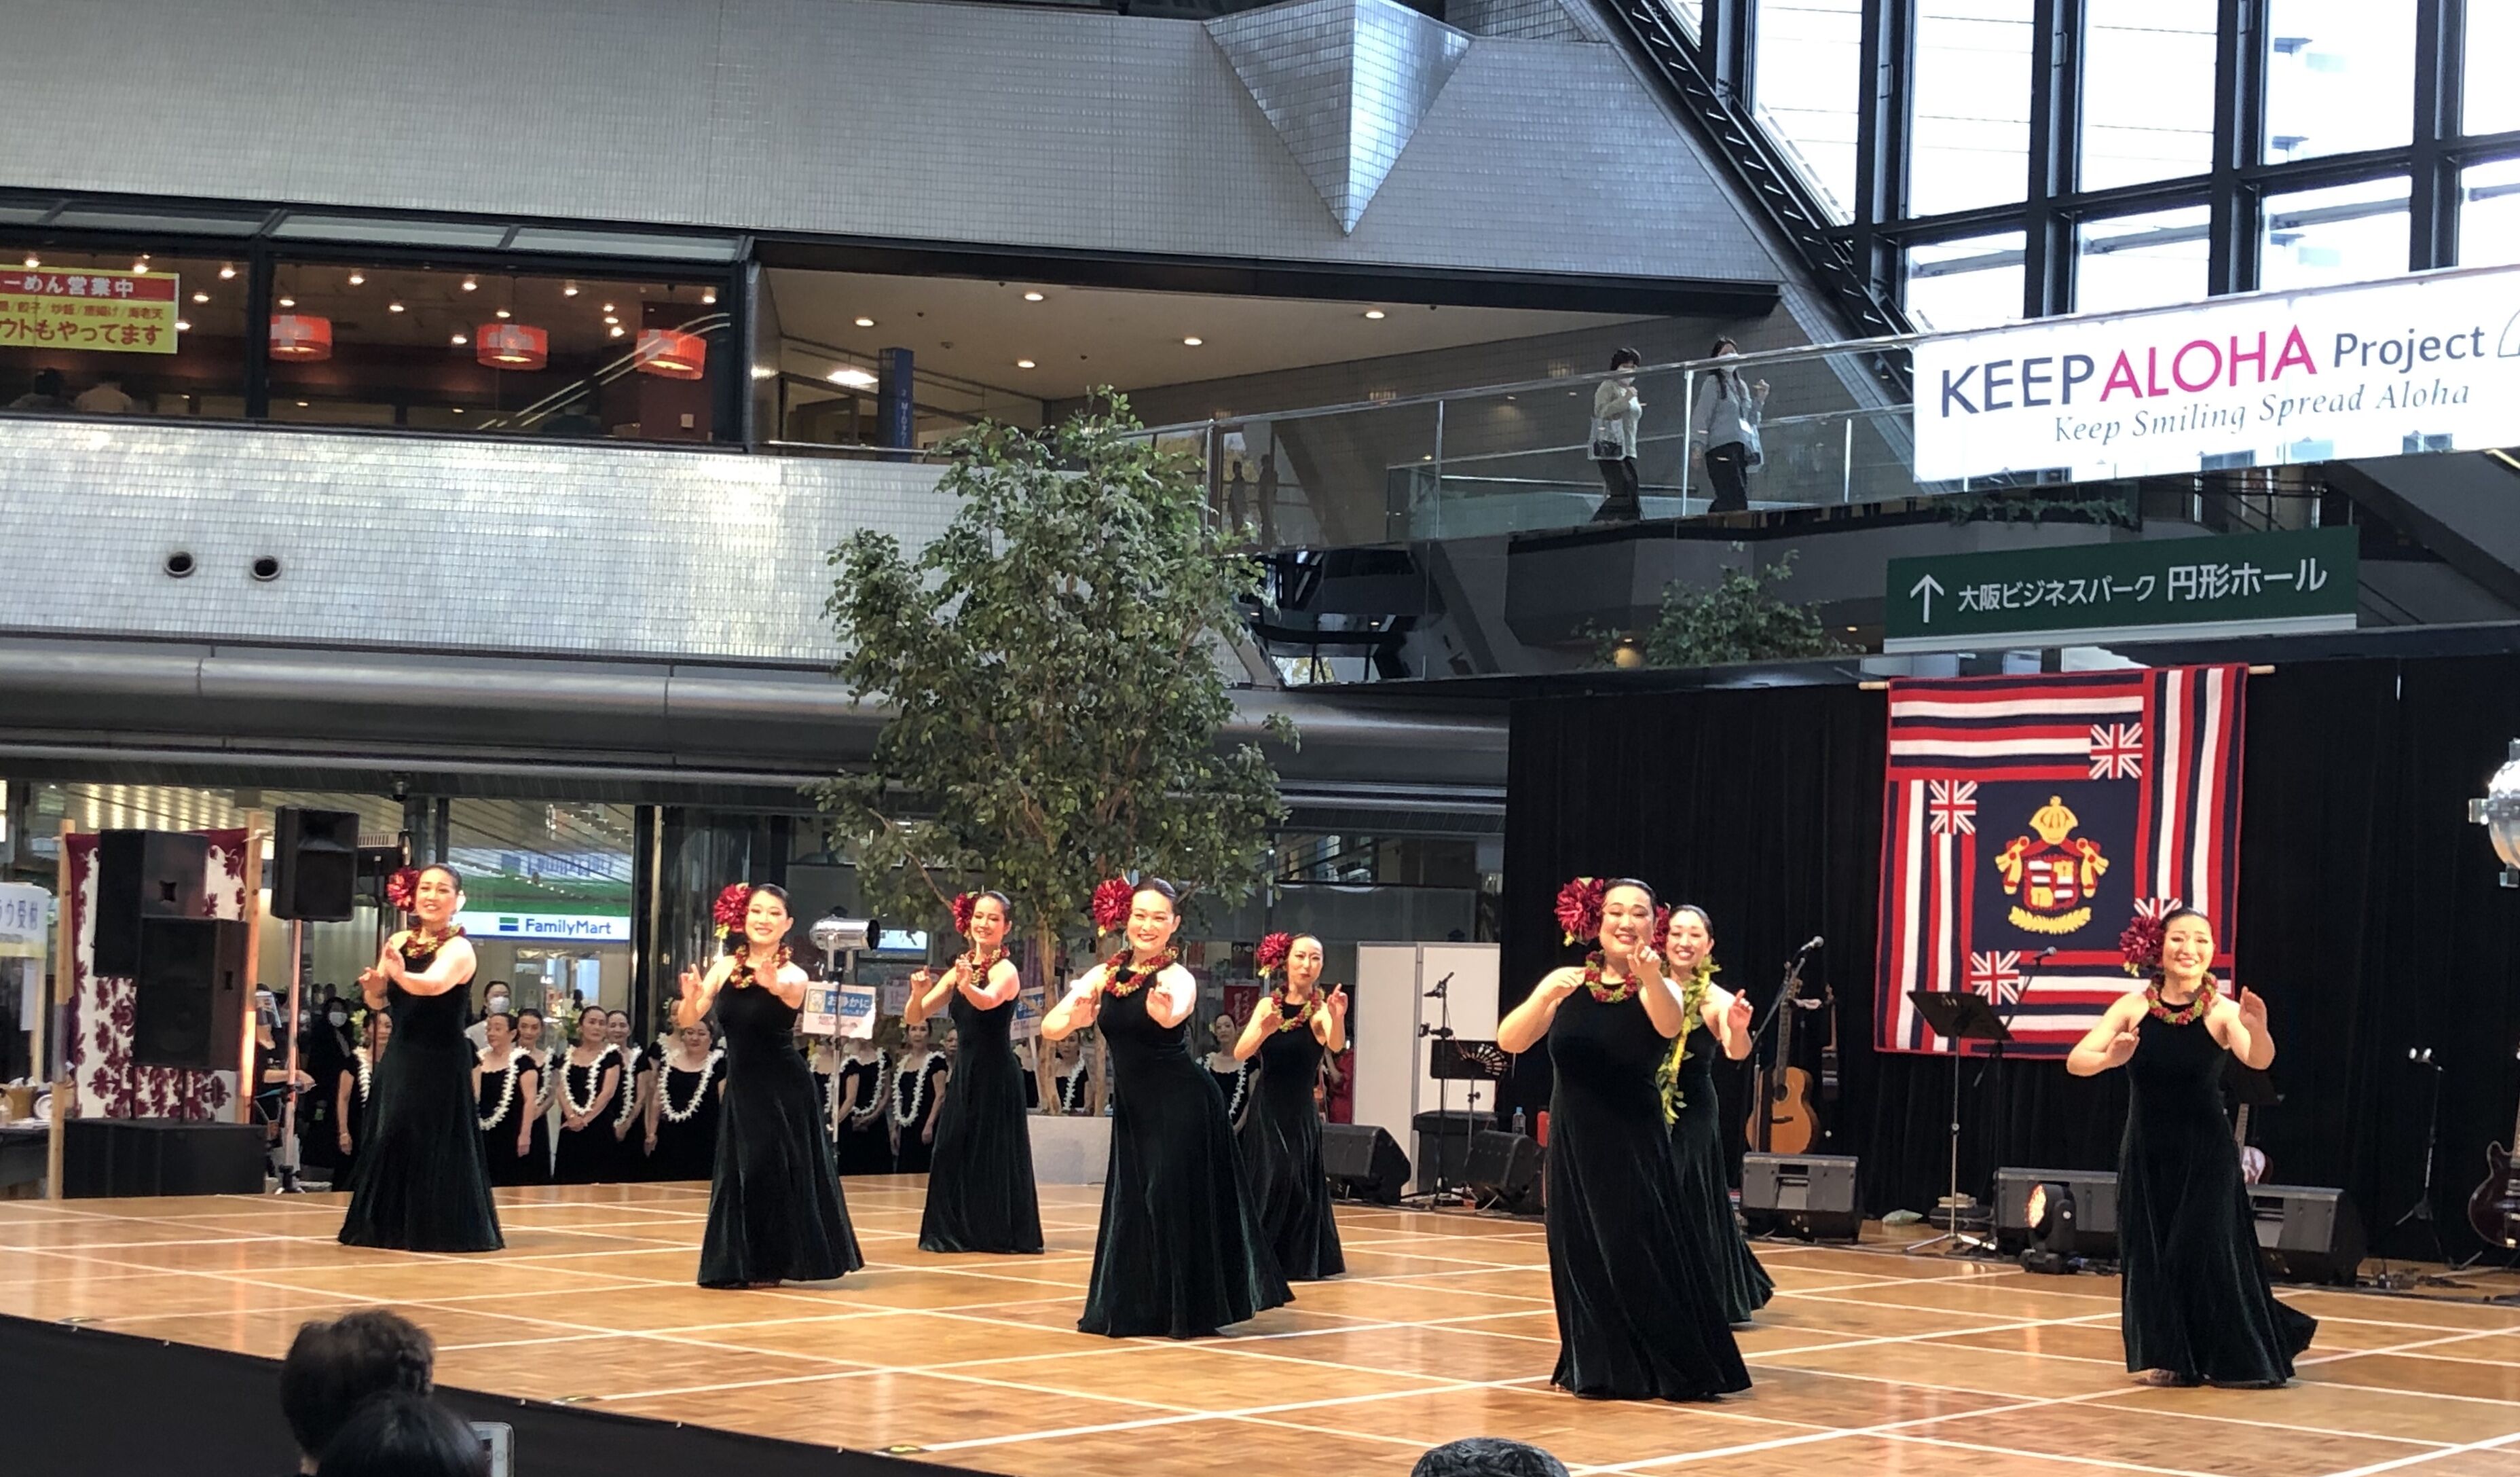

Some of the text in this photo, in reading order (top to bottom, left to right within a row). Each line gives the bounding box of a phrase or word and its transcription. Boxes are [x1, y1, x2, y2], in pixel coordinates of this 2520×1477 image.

[0, 275, 134, 298] ーめん営業中
[2334, 326, 2485, 374] Project
[2056, 378, 2469, 445] Keep Smiling Spread Aloha
[1958, 558, 2328, 612] 大阪ビジネスパーク 円形ホール
[525, 918, 612, 936] FamilyMart
[827, 995, 870, 1008] おかに
